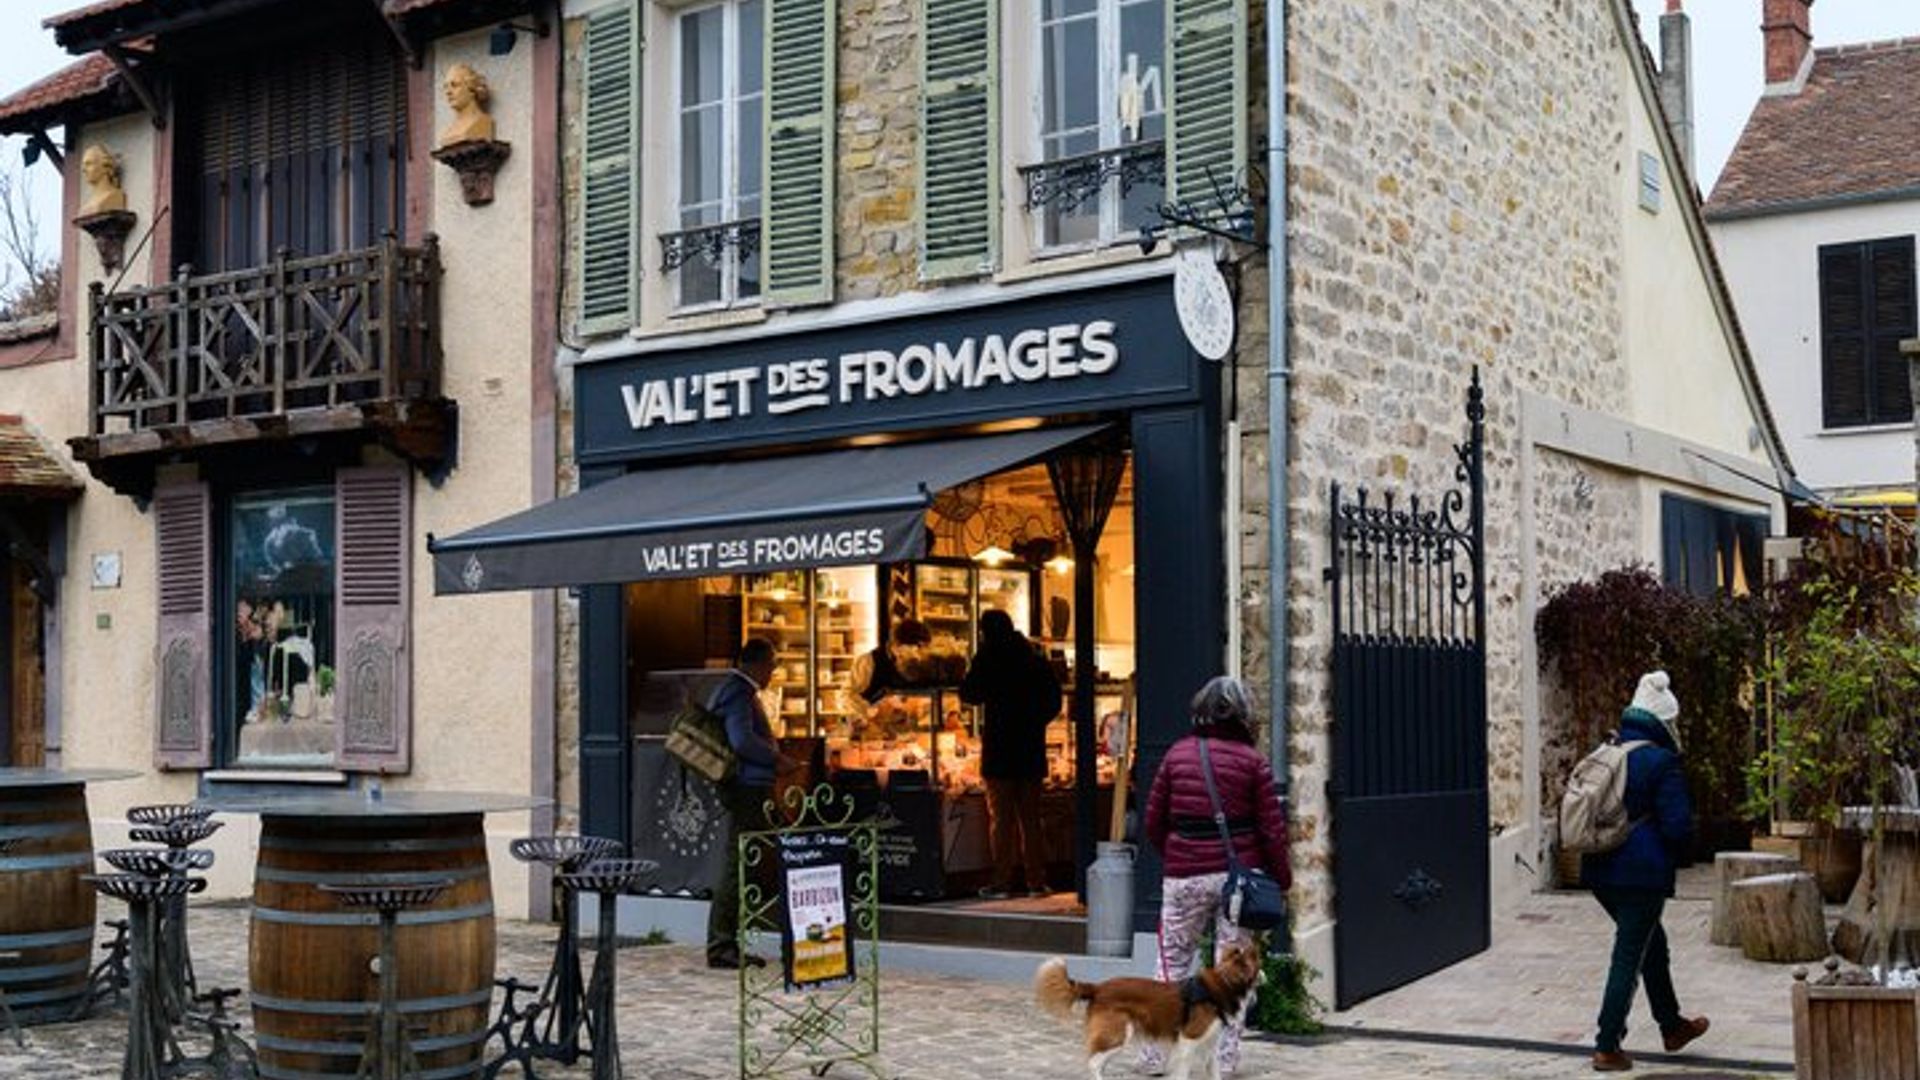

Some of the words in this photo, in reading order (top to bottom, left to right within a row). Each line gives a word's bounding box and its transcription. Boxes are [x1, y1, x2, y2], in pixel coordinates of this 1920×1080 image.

[768, 358, 830, 396] DES
[839, 320, 1118, 403] FROMAGES
[717, 540, 748, 559] DES
[754, 528, 884, 564] FROMAGES
